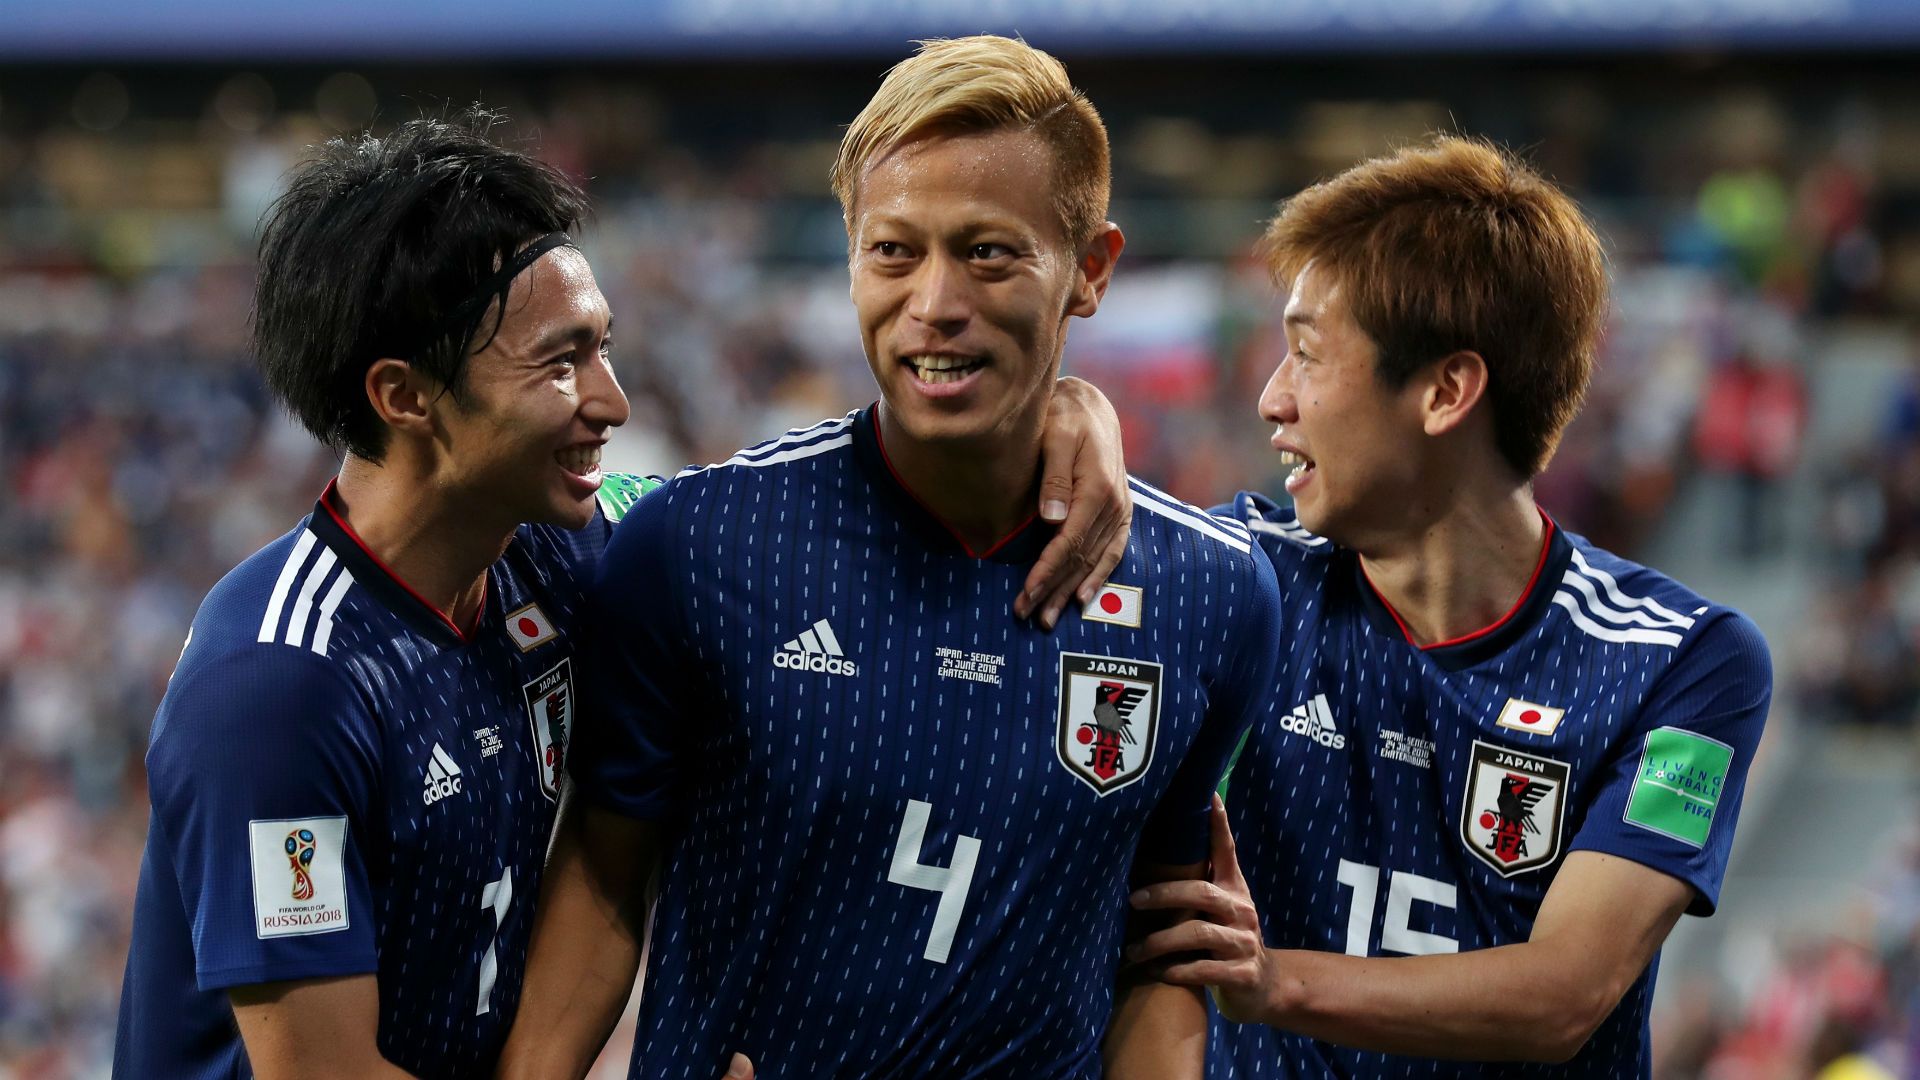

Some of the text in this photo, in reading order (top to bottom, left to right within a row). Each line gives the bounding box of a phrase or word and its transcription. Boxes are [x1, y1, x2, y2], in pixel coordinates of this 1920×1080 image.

[773, 649, 856, 677] adidas
[935, 647, 962, 659] JAPAN
[970, 652, 1006, 666] SENEGAL
[942, 658, 997, 674] 24 JUNE 2018
[937, 667, 1000, 684] EKATERINBURG
[1087, 661, 1138, 677] JAPAN
[539, 671, 561, 693] JAPAN
[1279, 714, 1346, 750] adidas
[1379, 728, 1404, 742] JAPAN
[1385, 739, 1395, 750] 24
[1083, 747, 1126, 772] JFA
[1495, 753, 1545, 773] JAPAN
[1648, 757, 1721, 787] LIVING
[1683, 801, 1712, 820] FIFA
[1485, 832, 1529, 858] JFA
[887, 799, 982, 964] 4
[292, 905, 315, 913] WORLD
[1336, 857, 1460, 958] 15
[264, 909, 342, 928] RUSSIA 2018
